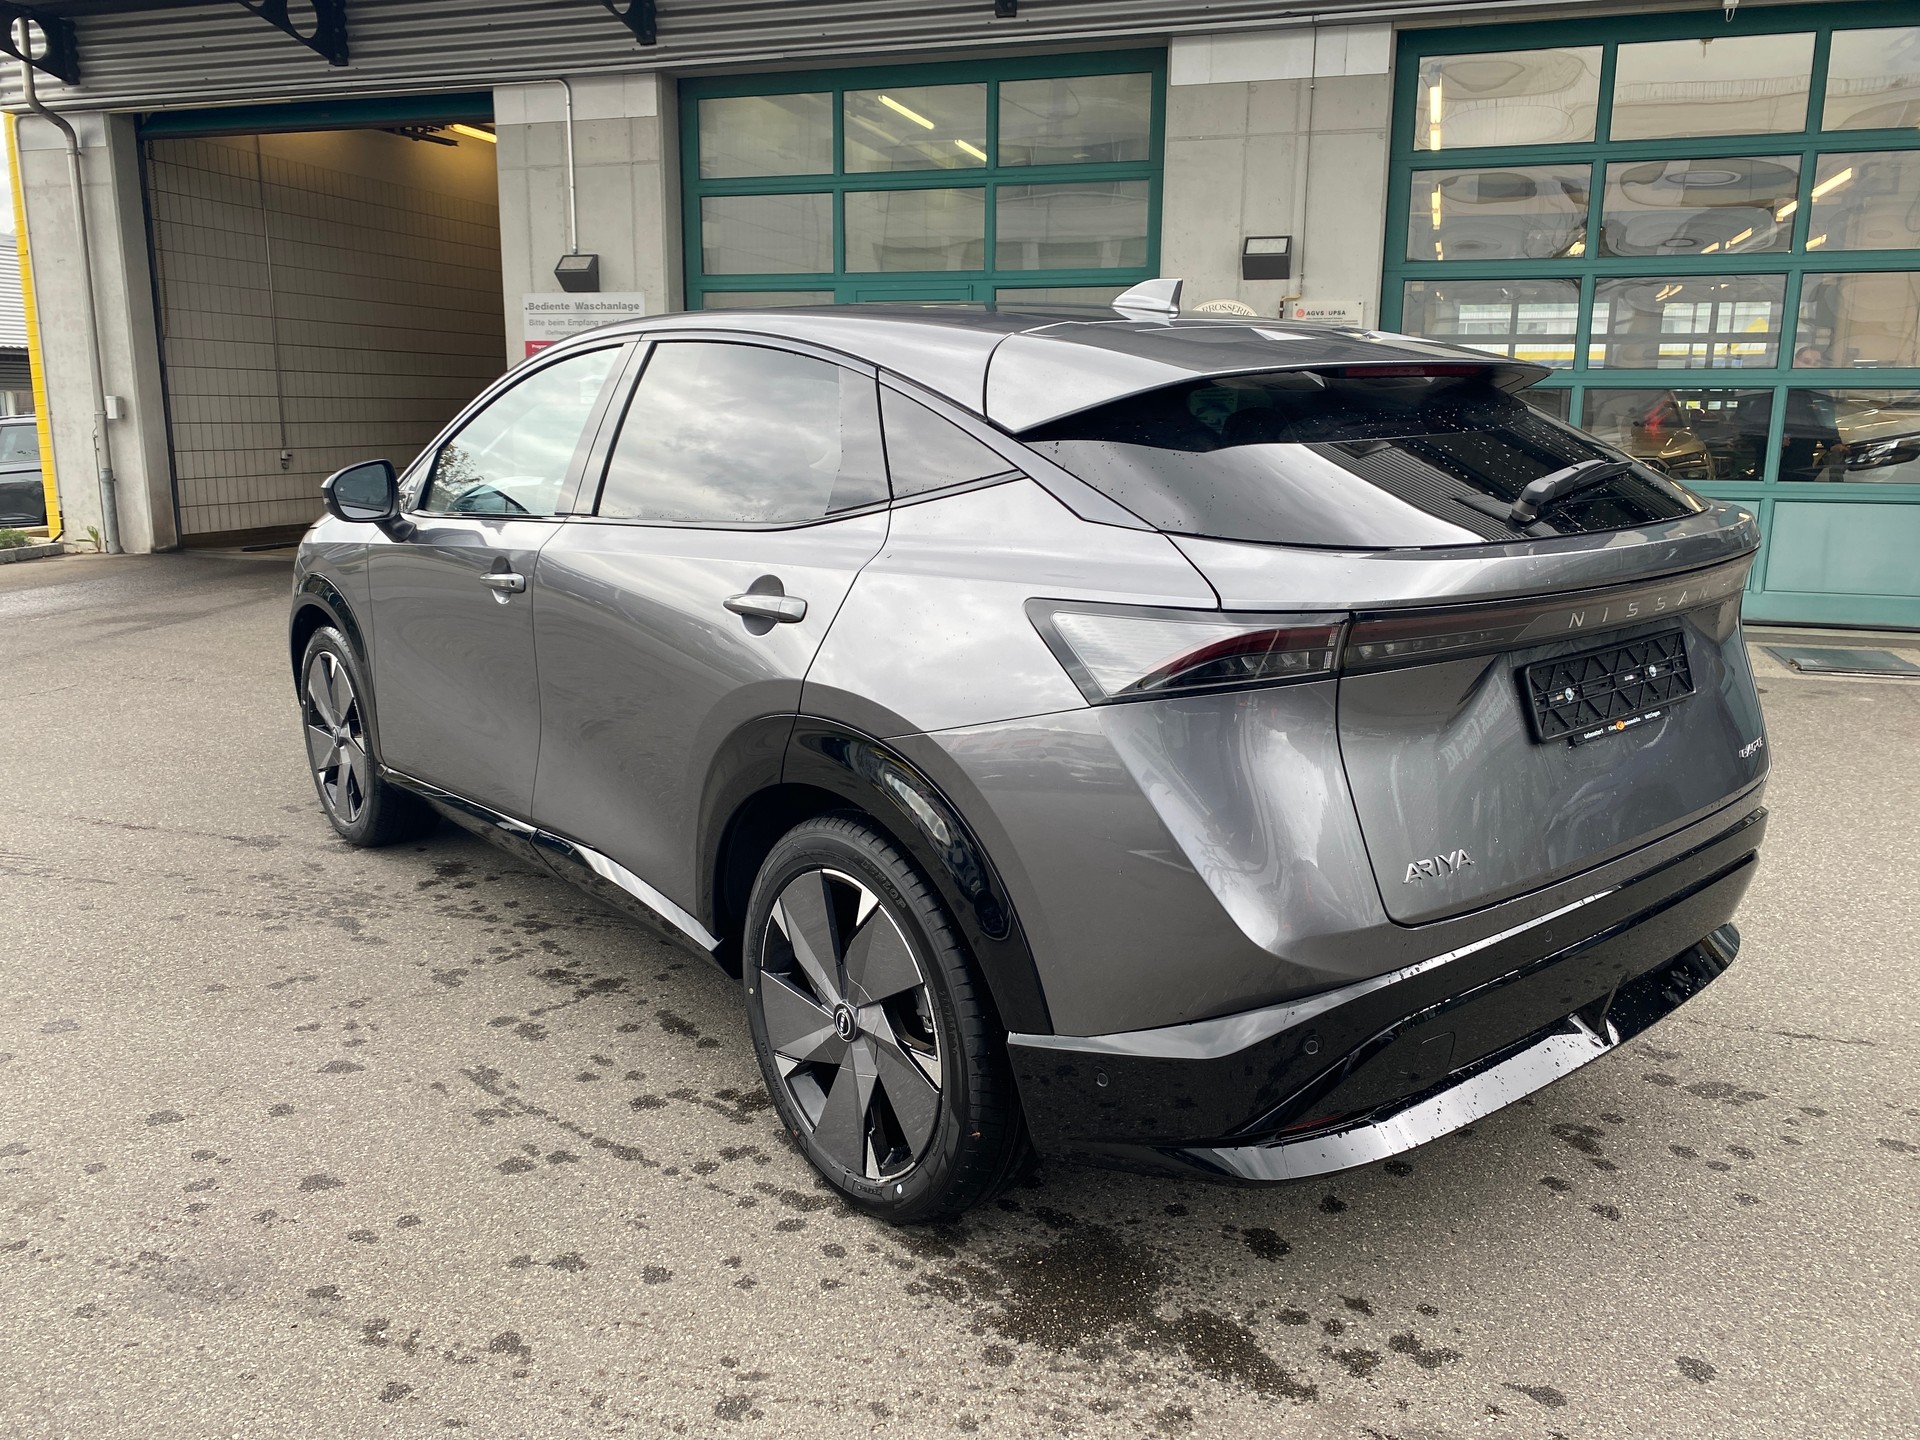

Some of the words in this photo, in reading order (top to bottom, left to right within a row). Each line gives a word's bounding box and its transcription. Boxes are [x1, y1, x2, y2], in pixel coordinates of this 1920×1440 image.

[528, 302, 570, 311] Bediente
[575, 302, 640, 312] Waschanlage
[568, 319, 599, 328] Empfang
[1568, 585, 1710, 629] NISSAN
[1403, 848, 1475, 884] ARIYA
